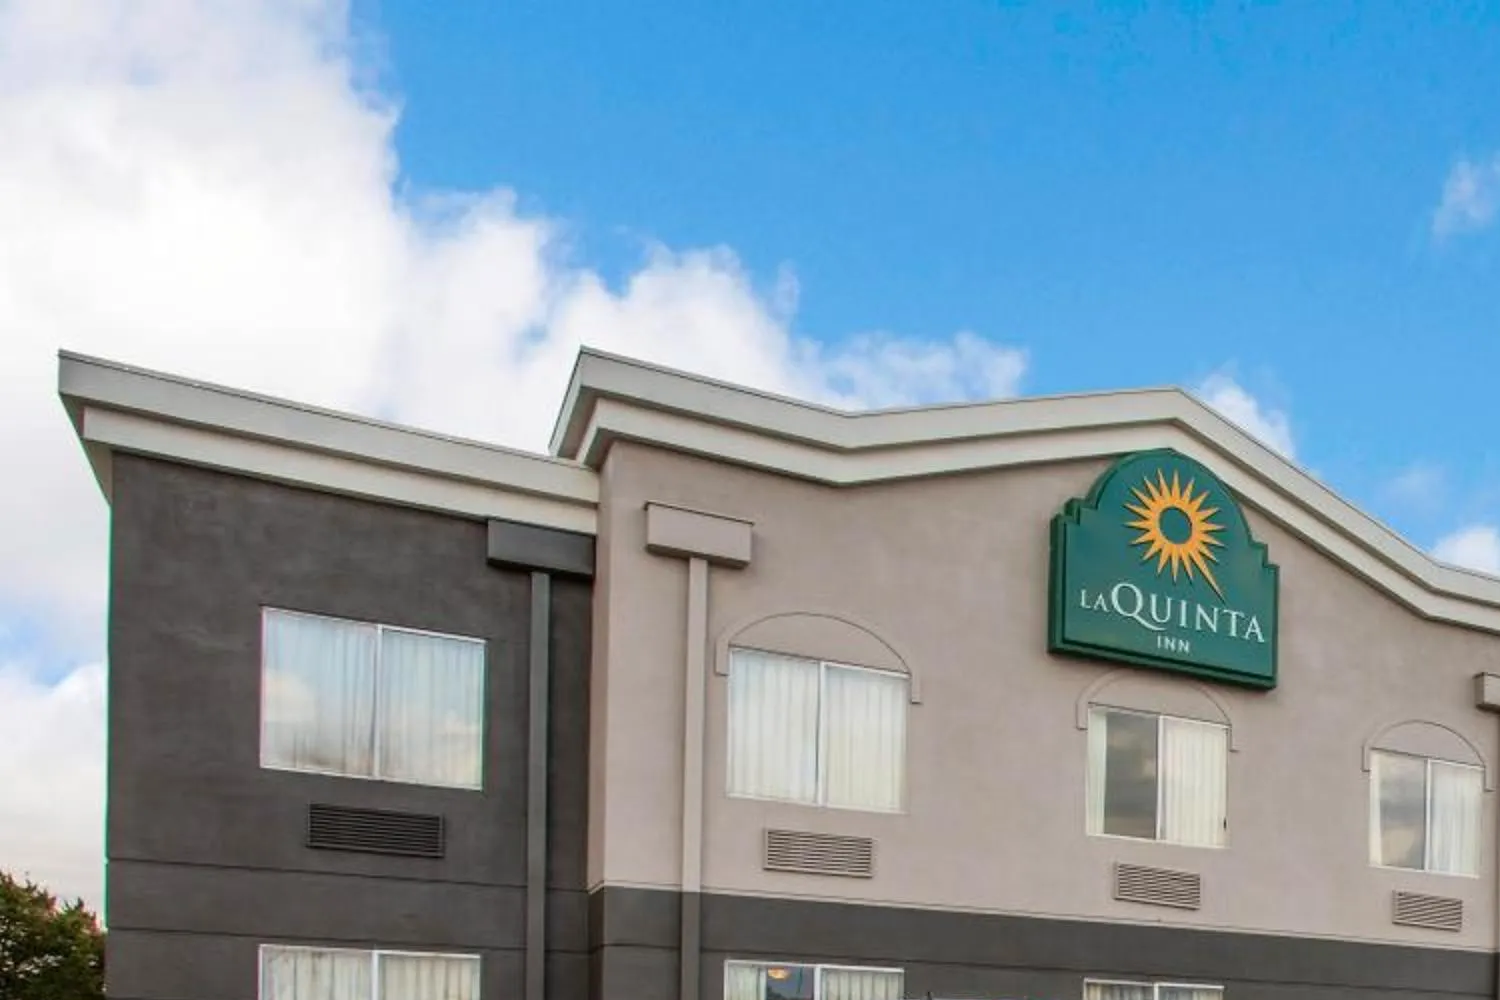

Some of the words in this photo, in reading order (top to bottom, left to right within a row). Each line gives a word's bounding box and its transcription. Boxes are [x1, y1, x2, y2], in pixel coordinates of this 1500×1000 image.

[1080, 589, 1110, 613] LA
[1111, 582, 1265, 643] QUINTA
[1156, 635, 1191, 653] INN
